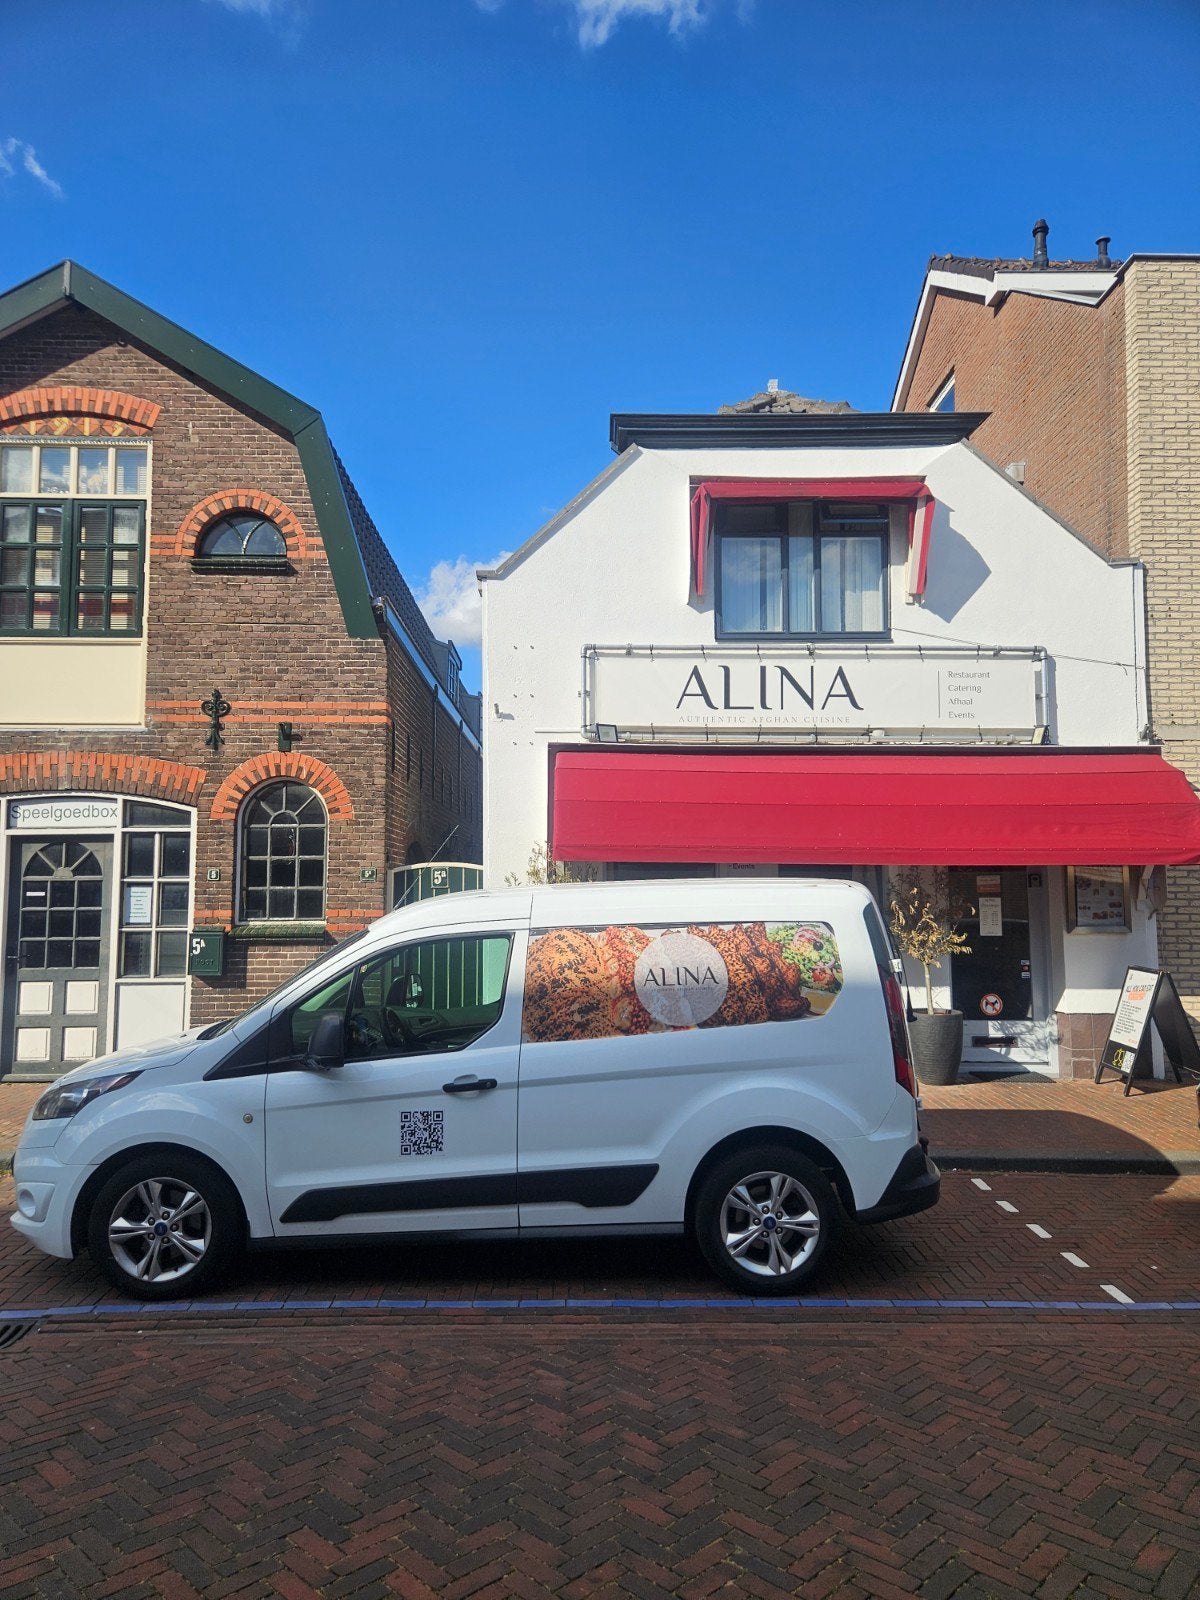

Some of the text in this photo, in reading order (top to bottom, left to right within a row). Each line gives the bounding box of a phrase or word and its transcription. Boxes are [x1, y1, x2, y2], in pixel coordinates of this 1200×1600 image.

[947, 670, 991, 679] Restaurant
[675, 664, 865, 711] ALINA
[947, 684, 982, 694] Catering
[948, 697, 973, 706] Afhaal
[678, 715, 851, 724] AUTHENTIC AFGHAN CUISINE
[948, 711, 975, 719] Events
[11, 804, 118, 822] Speelgoedbox
[643, 965, 720, 987] ALINA
